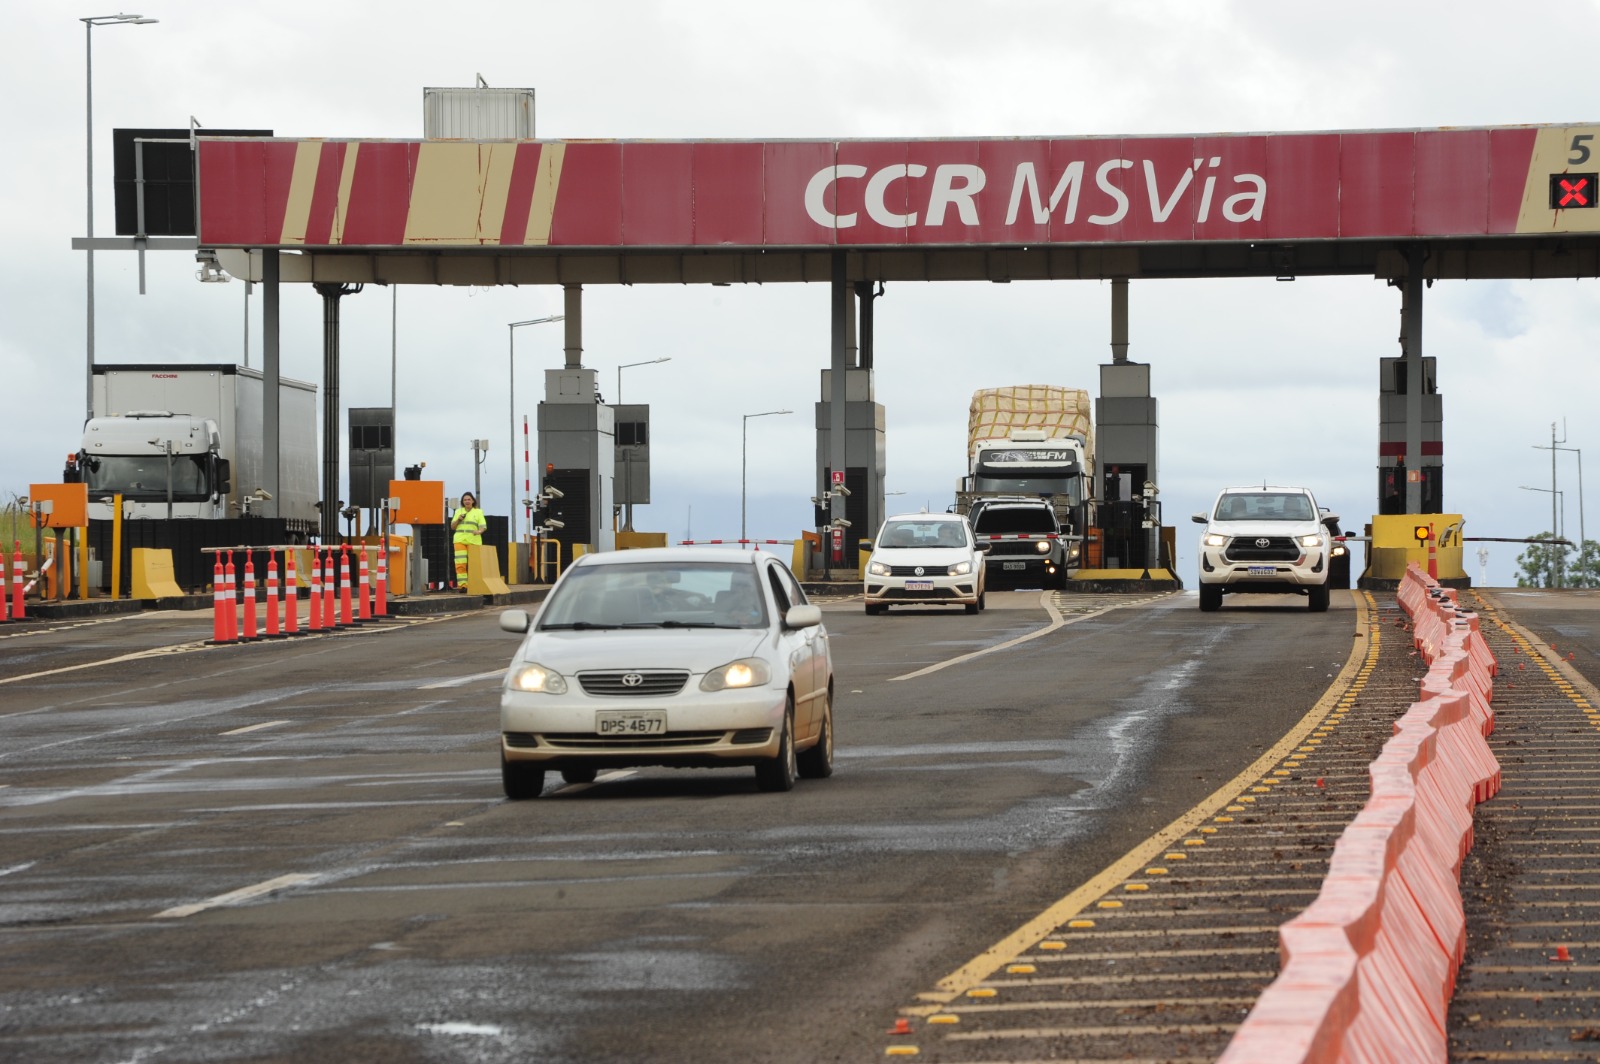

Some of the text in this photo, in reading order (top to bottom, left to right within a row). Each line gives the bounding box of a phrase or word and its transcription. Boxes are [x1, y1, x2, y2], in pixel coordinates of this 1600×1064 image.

[1567, 134, 1594, 165] 5
[803, 156, 1268, 229] CCR MSVia
[1046, 451, 1067, 460] FM
